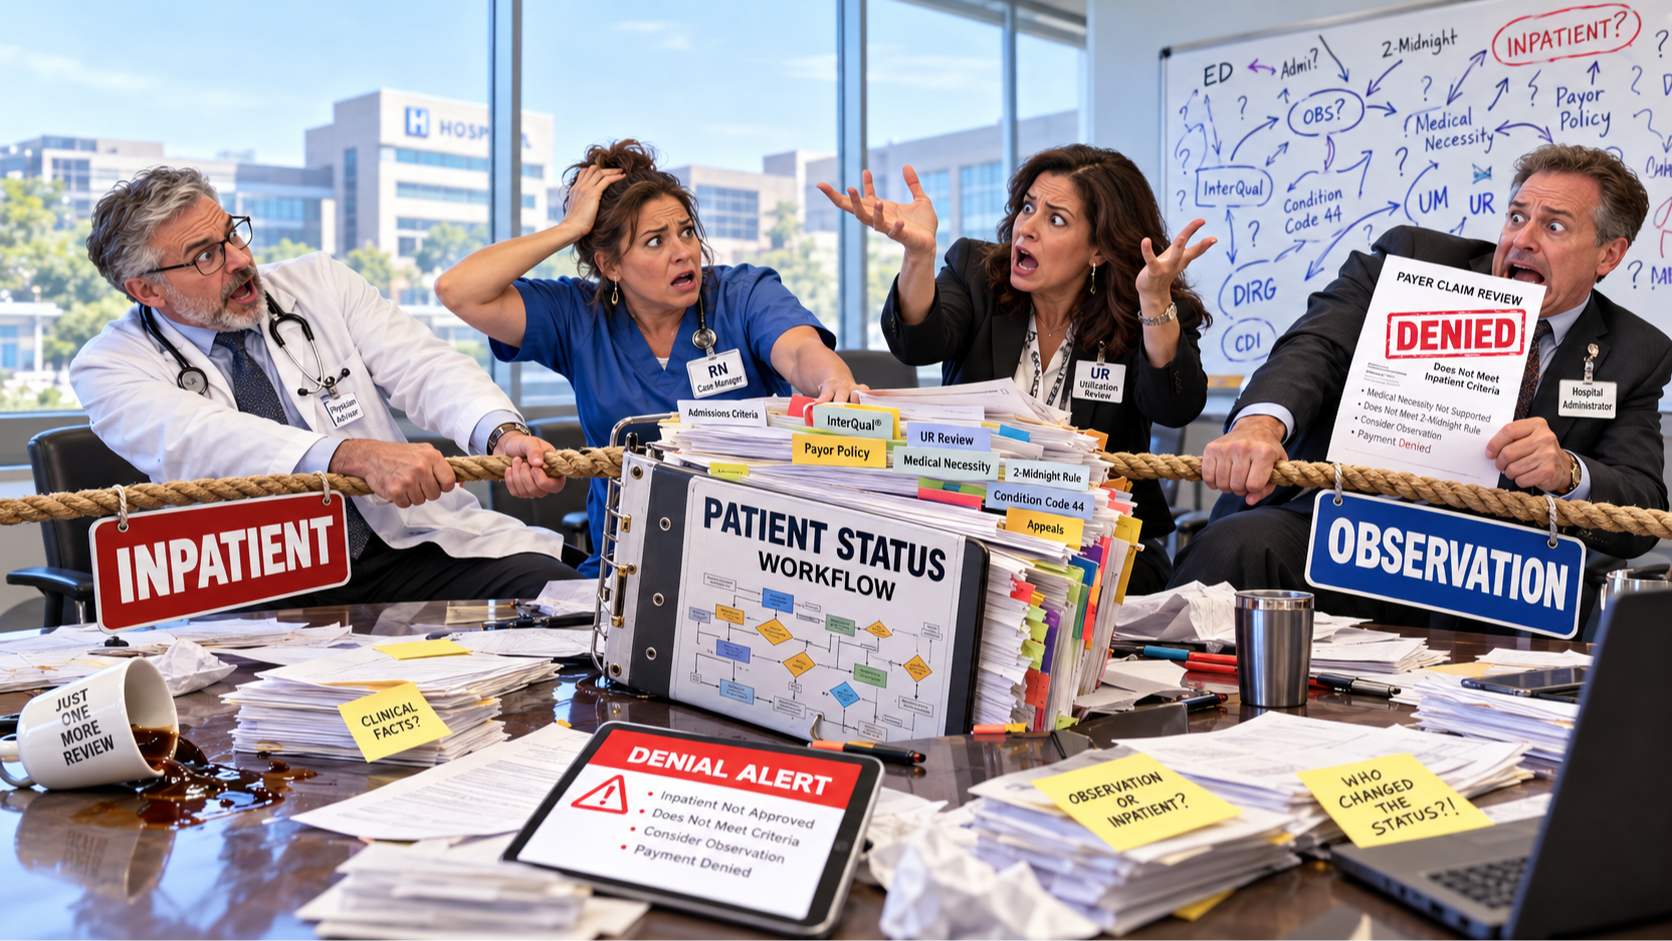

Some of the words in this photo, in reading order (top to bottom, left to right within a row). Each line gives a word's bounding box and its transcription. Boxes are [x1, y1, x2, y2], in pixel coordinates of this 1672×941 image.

[1382, 27, 1458, 58] 2-Midnight
[1508, 10, 1627, 58] INPATIENT?
[1204, 62, 1233, 87] ED
[1556, 86, 1605, 110] Payor
[1303, 98, 1345, 125] OBS?
[1416, 106, 1472, 135] Medical
[1561, 108, 1611, 138] Policy
[1425, 126, 1494, 154] Necessity
[1204, 179, 1263, 197] InterQual
[1283, 188, 1343, 214] Condition
[1419, 185, 1449, 214] UM
[1469, 192, 1496, 215] UR
[1285, 211, 1319, 235] Code
[1324, 204, 1342, 224] 44
[1233, 277, 1277, 307] DIRG
[1396, 271, 1434, 288] PAYER
[1437, 280, 1475, 297] CLAIM
[1477, 288, 1523, 306] REVIEW
[1235, 331, 1260, 353] CDI
[1396, 318, 1516, 351] DENIED
[707, 362, 728, 378] RN
[714, 375, 743, 388] Manager
[1091, 367, 1110, 380] UR
[1433, 362, 1456, 376] Does
[1458, 367, 1474, 378] Not
[1476, 371, 1500, 383] Meet
[1424, 372, 1465, 389] Inpatient
[1466, 381, 1500, 395] Criteria
[1571, 386, 1604, 399] Hospital
[688, 408, 730, 419] Admissions
[732, 409, 759, 420] Criteria
[1363, 401, 1383, 413] Does
[1384, 405, 1398, 417] Not
[1399, 409, 1418, 421] Meet
[1420, 413, 1462, 431] 2-Midnight
[1463, 424, 1482, 435] Rule
[1366, 388, 1396, 402] Medical
[1397, 395, 1434, 413] Necessity
[1435, 403, 1449, 414] Not
[1451, 407, 1491, 423] Supported
[1562, 399, 1613, 411] Administrator
[920, 431, 935, 443] UR
[938, 432, 974, 446] Review
[1360, 415, 1395, 431] Consider
[1396, 422, 1442, 441] Observation
[804, 442, 835, 456] Payor
[837, 444, 870, 460] Policy
[1357, 429, 1396, 446] Payment
[1398, 438, 1432, 454] Denied
[903, 455, 941, 468] Medical
[944, 458, 991, 475] Necessity
[1013, 467, 1061, 482] 2-Midnight
[1063, 472, 1082, 483] Rule
[994, 490, 1042, 506] Condition
[1045, 497, 1070, 510] Code
[1072, 501, 1084, 511] 44
[703, 496, 828, 555] PATIENT
[836, 526, 947, 582] STATUS
[1027, 519, 1064, 535] Appeals
[116, 515, 334, 604] INPATIENT
[1328, 516, 1569, 611] OBSERVATION
[758, 550, 896, 601] WORKFLOW
[55, 688, 88, 712] JUST
[61, 704, 91, 726] ONE
[361, 702, 418, 727] CLINICAL
[373, 715, 420, 740] FACTS?
[60, 720, 101, 747] MORE
[63, 734, 114, 766] REVIEW
[626, 746, 728, 778] DENIAL
[735, 763, 833, 796] ALERT
[1340, 769, 1381, 788] WHO
[1068, 770, 1164, 806] OBSERVATION
[1116, 793, 1140, 808] OR
[1338, 779, 1414, 809] CHANGED
[660, 790, 718, 811] Inpatient
[721, 801, 745, 816] Not
[748, 807, 815, 830] Approved
[1107, 792, 1189, 828] INPATIENT?
[1371, 797, 1460, 836] STATUS?!
[1374, 796, 1412, 814] THE
[652, 808, 684, 823] Does
[687, 814, 711, 829] Not
[714, 820, 748, 836] Meet
[751, 827, 800, 848] Criteria
[643, 825, 702, 847] Consider
[705, 837, 785, 865] Observation
[633, 844, 696, 867] Payment
[700, 857, 752, 879] Denied
